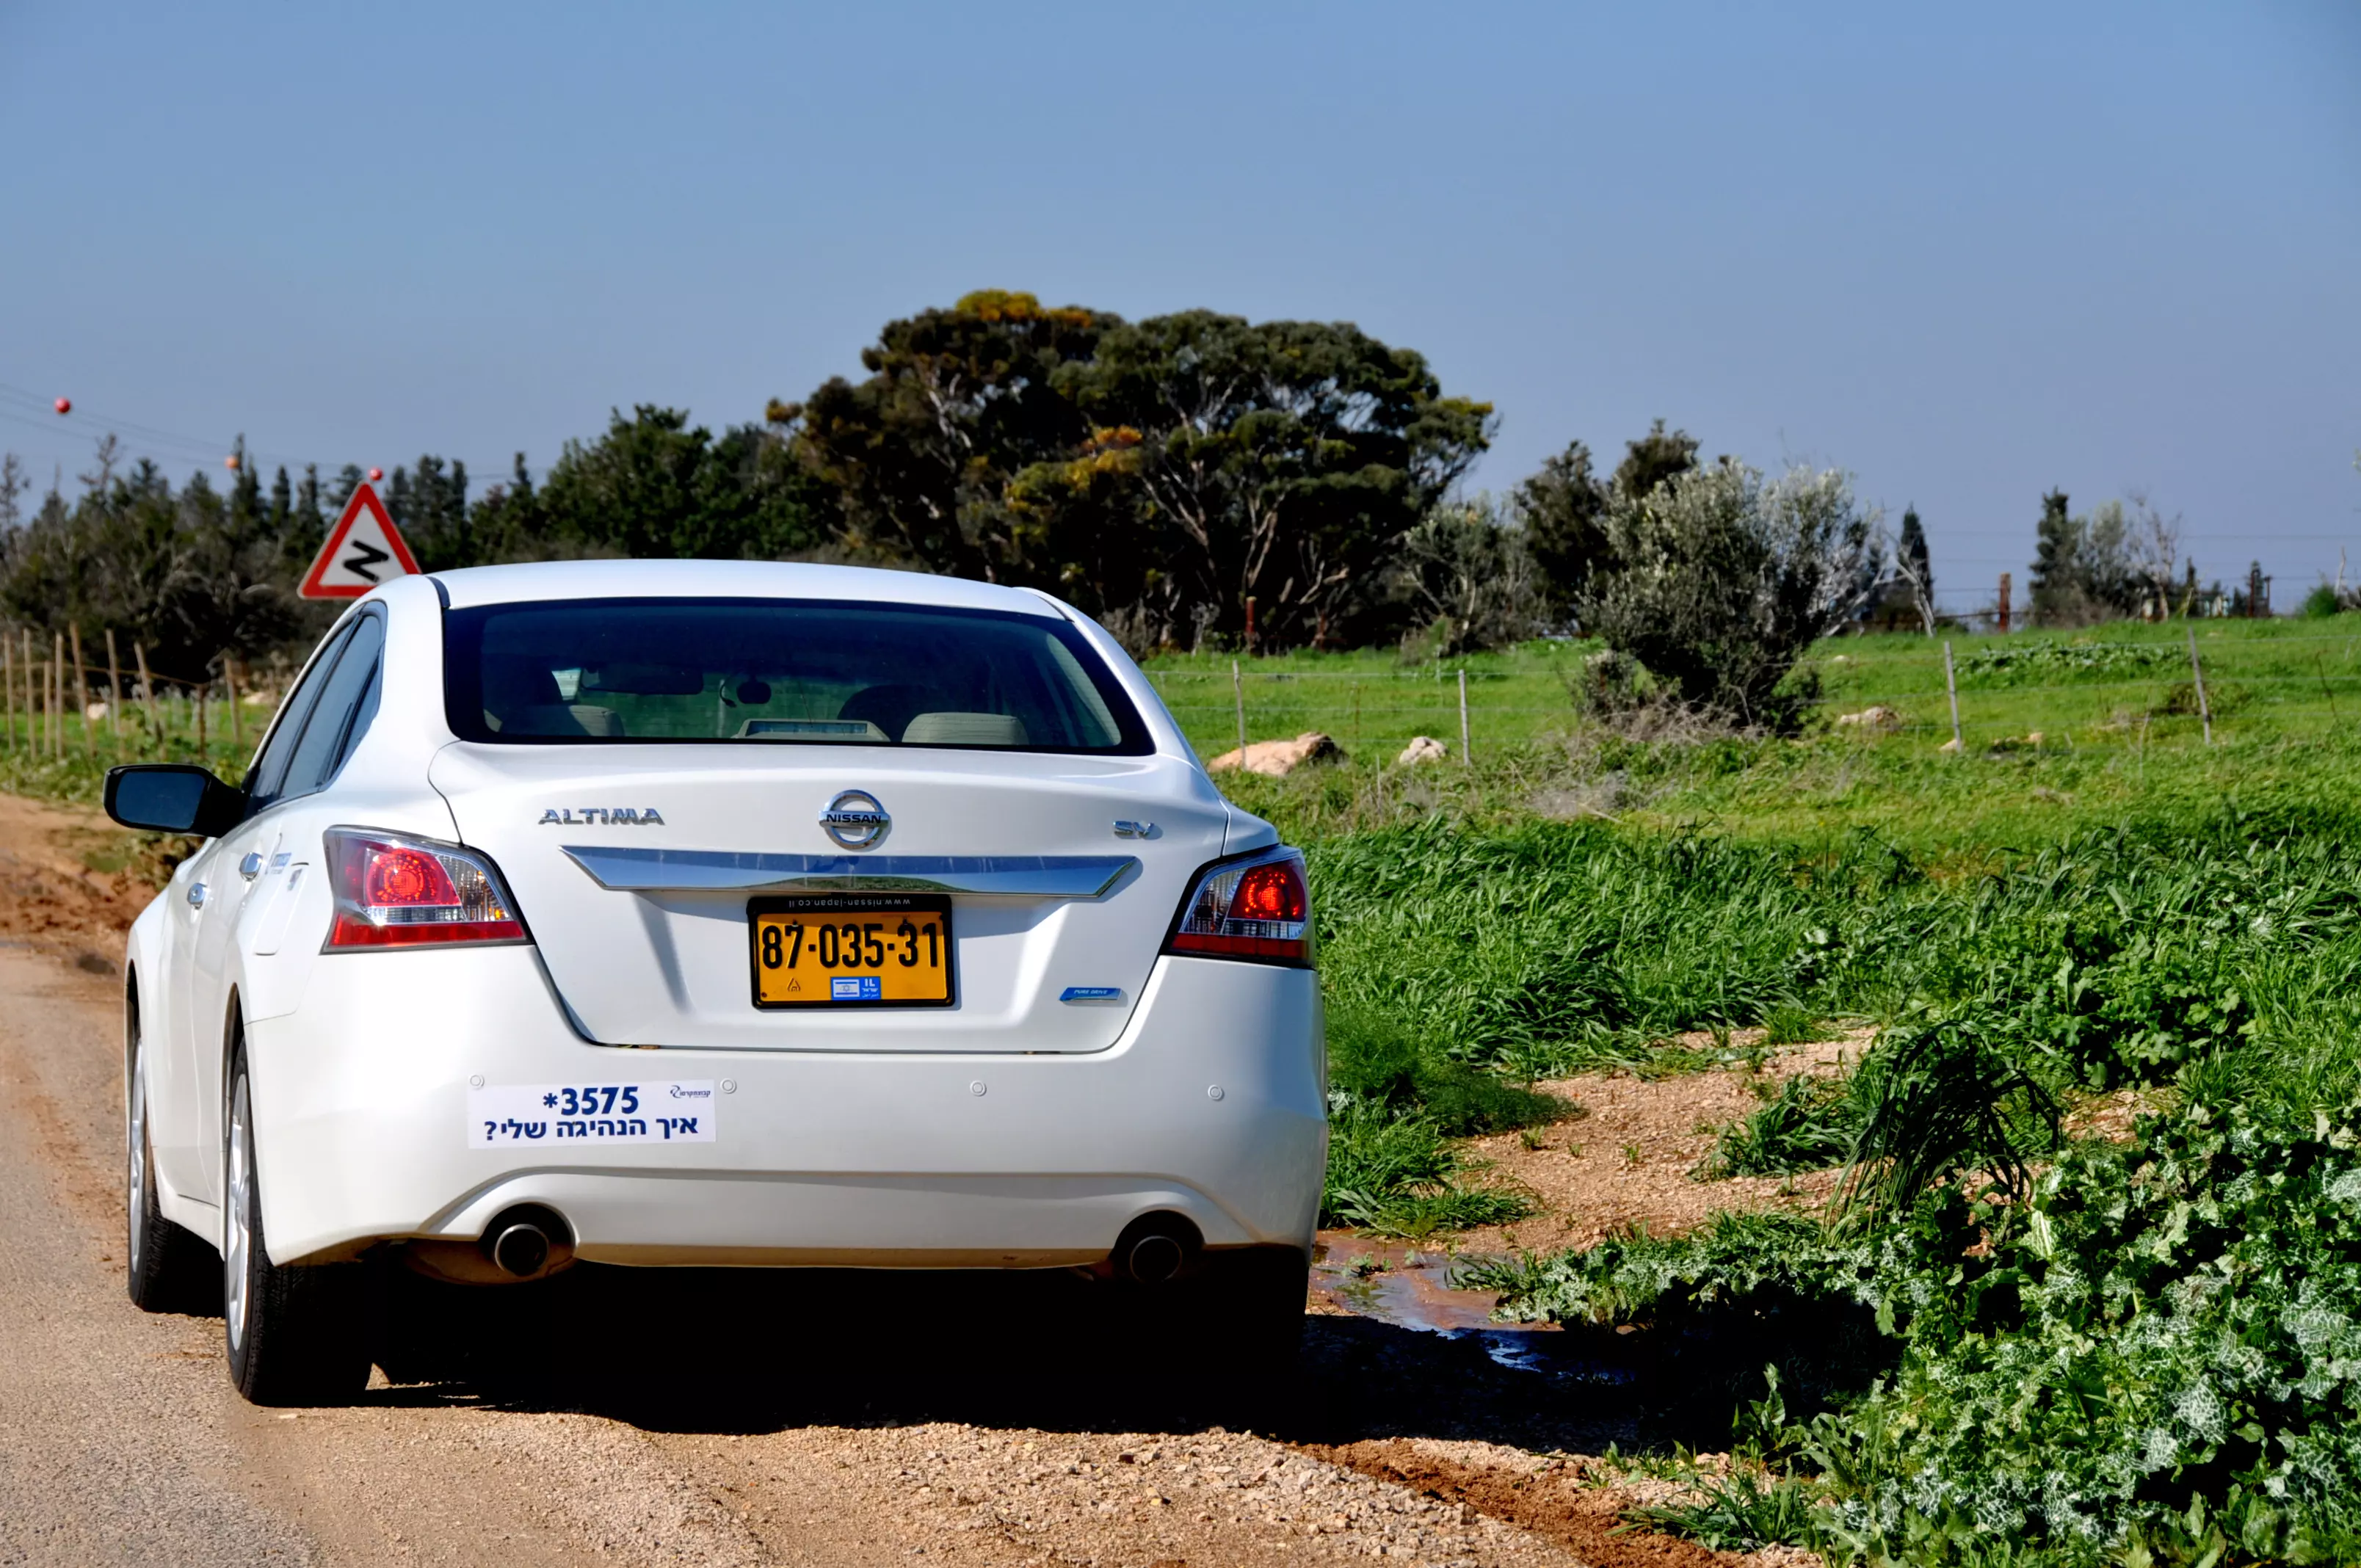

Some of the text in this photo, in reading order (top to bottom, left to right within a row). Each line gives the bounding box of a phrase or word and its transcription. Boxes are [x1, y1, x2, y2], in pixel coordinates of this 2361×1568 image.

[538, 807, 666, 826] ALTIMA
[826, 813, 881, 824] NISSAN
[864, 978, 875, 987] IL
[484, 1117, 698, 1141] איך הנהיגה שלי?
